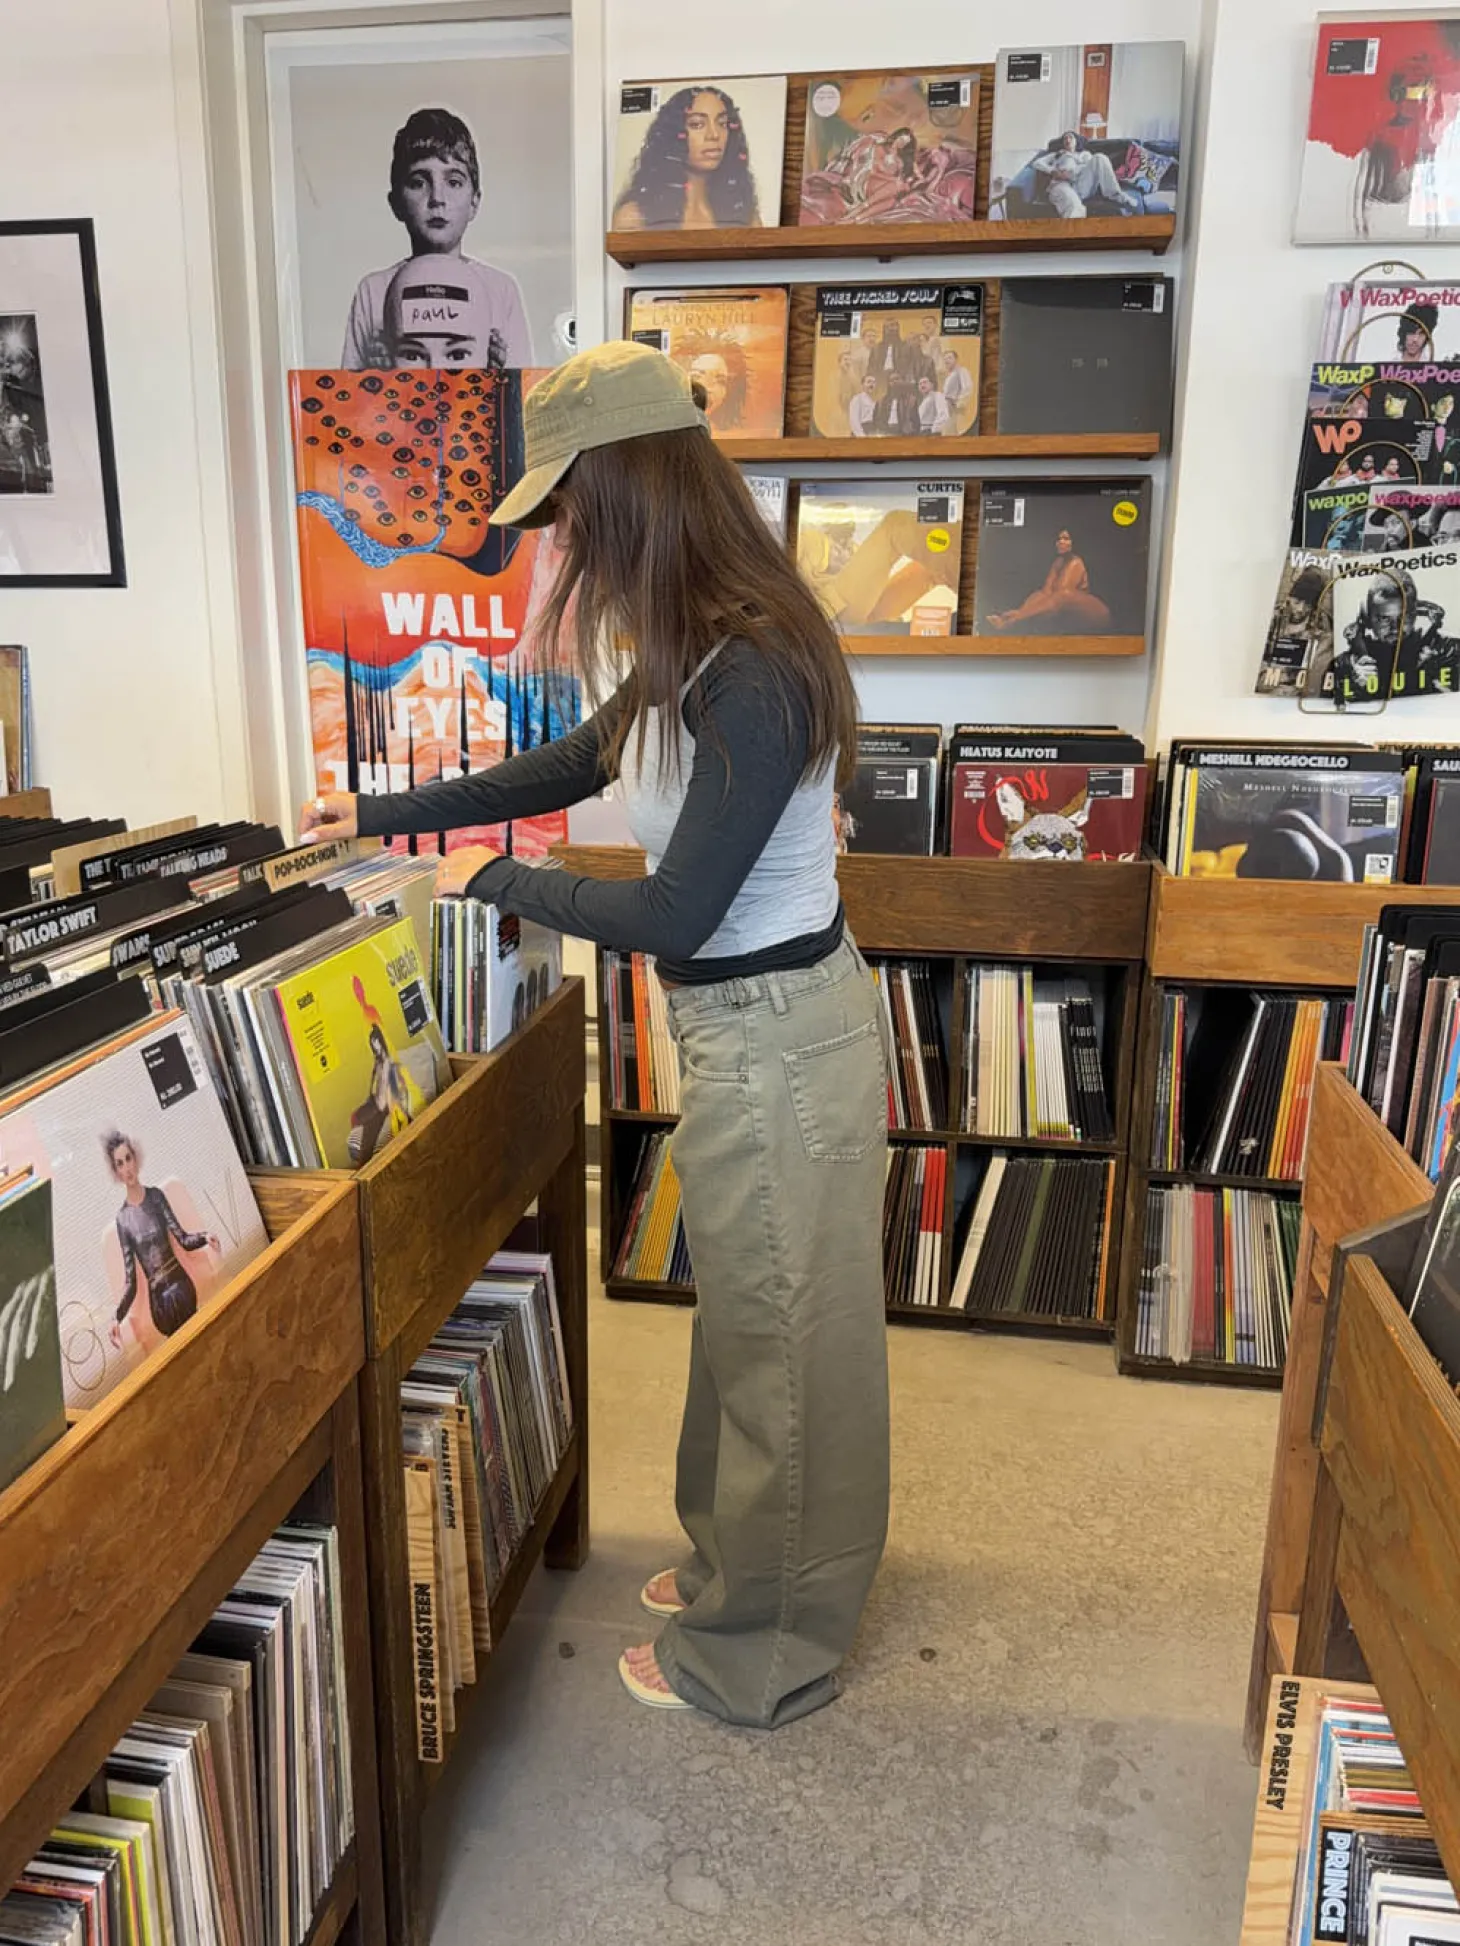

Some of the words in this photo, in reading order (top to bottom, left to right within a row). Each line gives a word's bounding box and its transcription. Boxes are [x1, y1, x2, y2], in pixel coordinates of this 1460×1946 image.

[651, 311, 716, 326] LAURYN
[1318, 365, 1375, 385] WaxP
[1313, 420, 1362, 454] WP
[917, 483, 963, 493] CURTIS
[1338, 551, 1459, 579] WaxPoetics
[381, 592, 516, 639] WALL
[421, 646, 478, 689] OF
[1343, 667, 1452, 697] LOUIE
[394, 697, 507, 741] EYES
[960, 746, 1002, 758] HIATUS
[1004, 747, 1058, 759] KAIYOTE
[1200, 753, 1252, 767] MESHELL
[1254, 754, 1350, 769] NDEGEOCELLO
[1432, 759, 1460, 772] SAU
[325, 760, 411, 796] THE
[7, 921, 60, 955] TAYLOR
[60, 906, 96, 935] SWIFT
[204, 941, 241, 973] SUEDE
[414, 1583, 437, 1700] SPRINGSTEEN
[1276, 1680, 1301, 1730] ELVIS
[420, 1702, 439, 1760] BRUCE
[1264, 1733, 1294, 1811] PRESLEY
[1320, 1831, 1352, 1935] PRINCE
